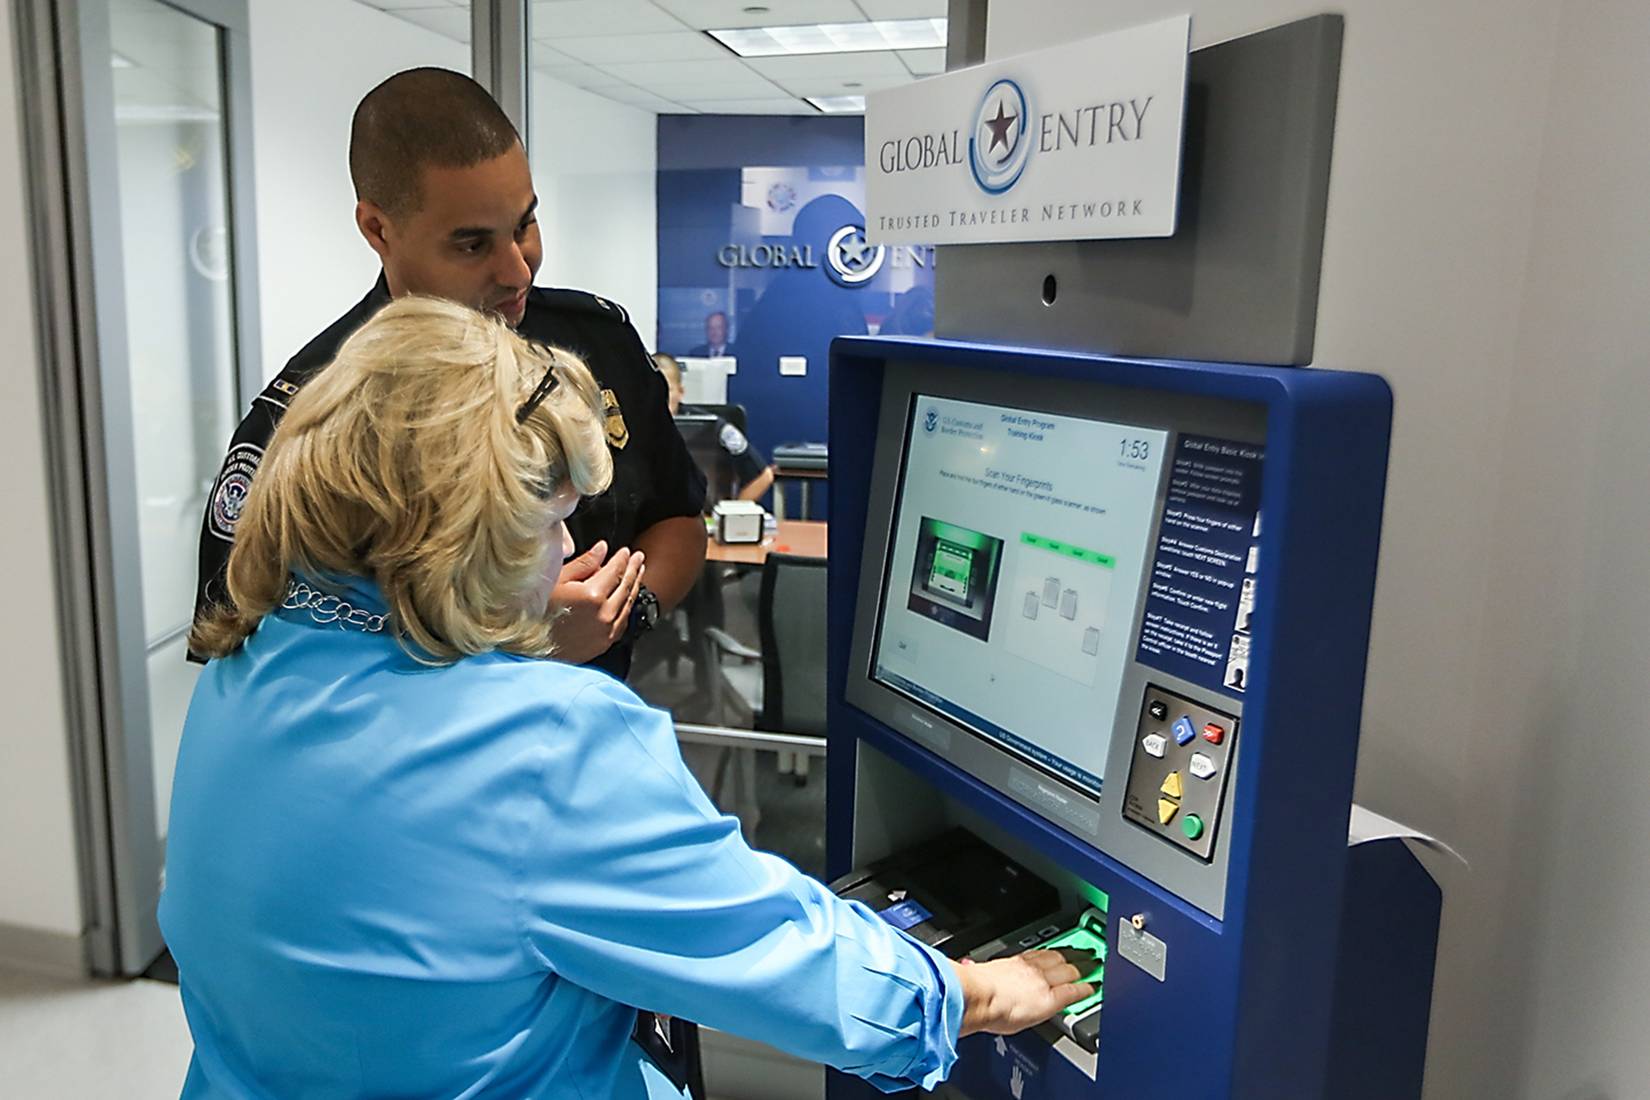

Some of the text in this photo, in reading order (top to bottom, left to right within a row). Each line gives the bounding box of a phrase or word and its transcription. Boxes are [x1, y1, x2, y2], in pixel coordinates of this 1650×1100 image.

[880, 96, 1153, 174] GLOBAL ENTRY
[880, 200, 1143, 231] TRUSTED TRAVELER NETWORK
[718, 244, 818, 268] GLOBAL
[1120, 439, 1149, 460] 1:53
